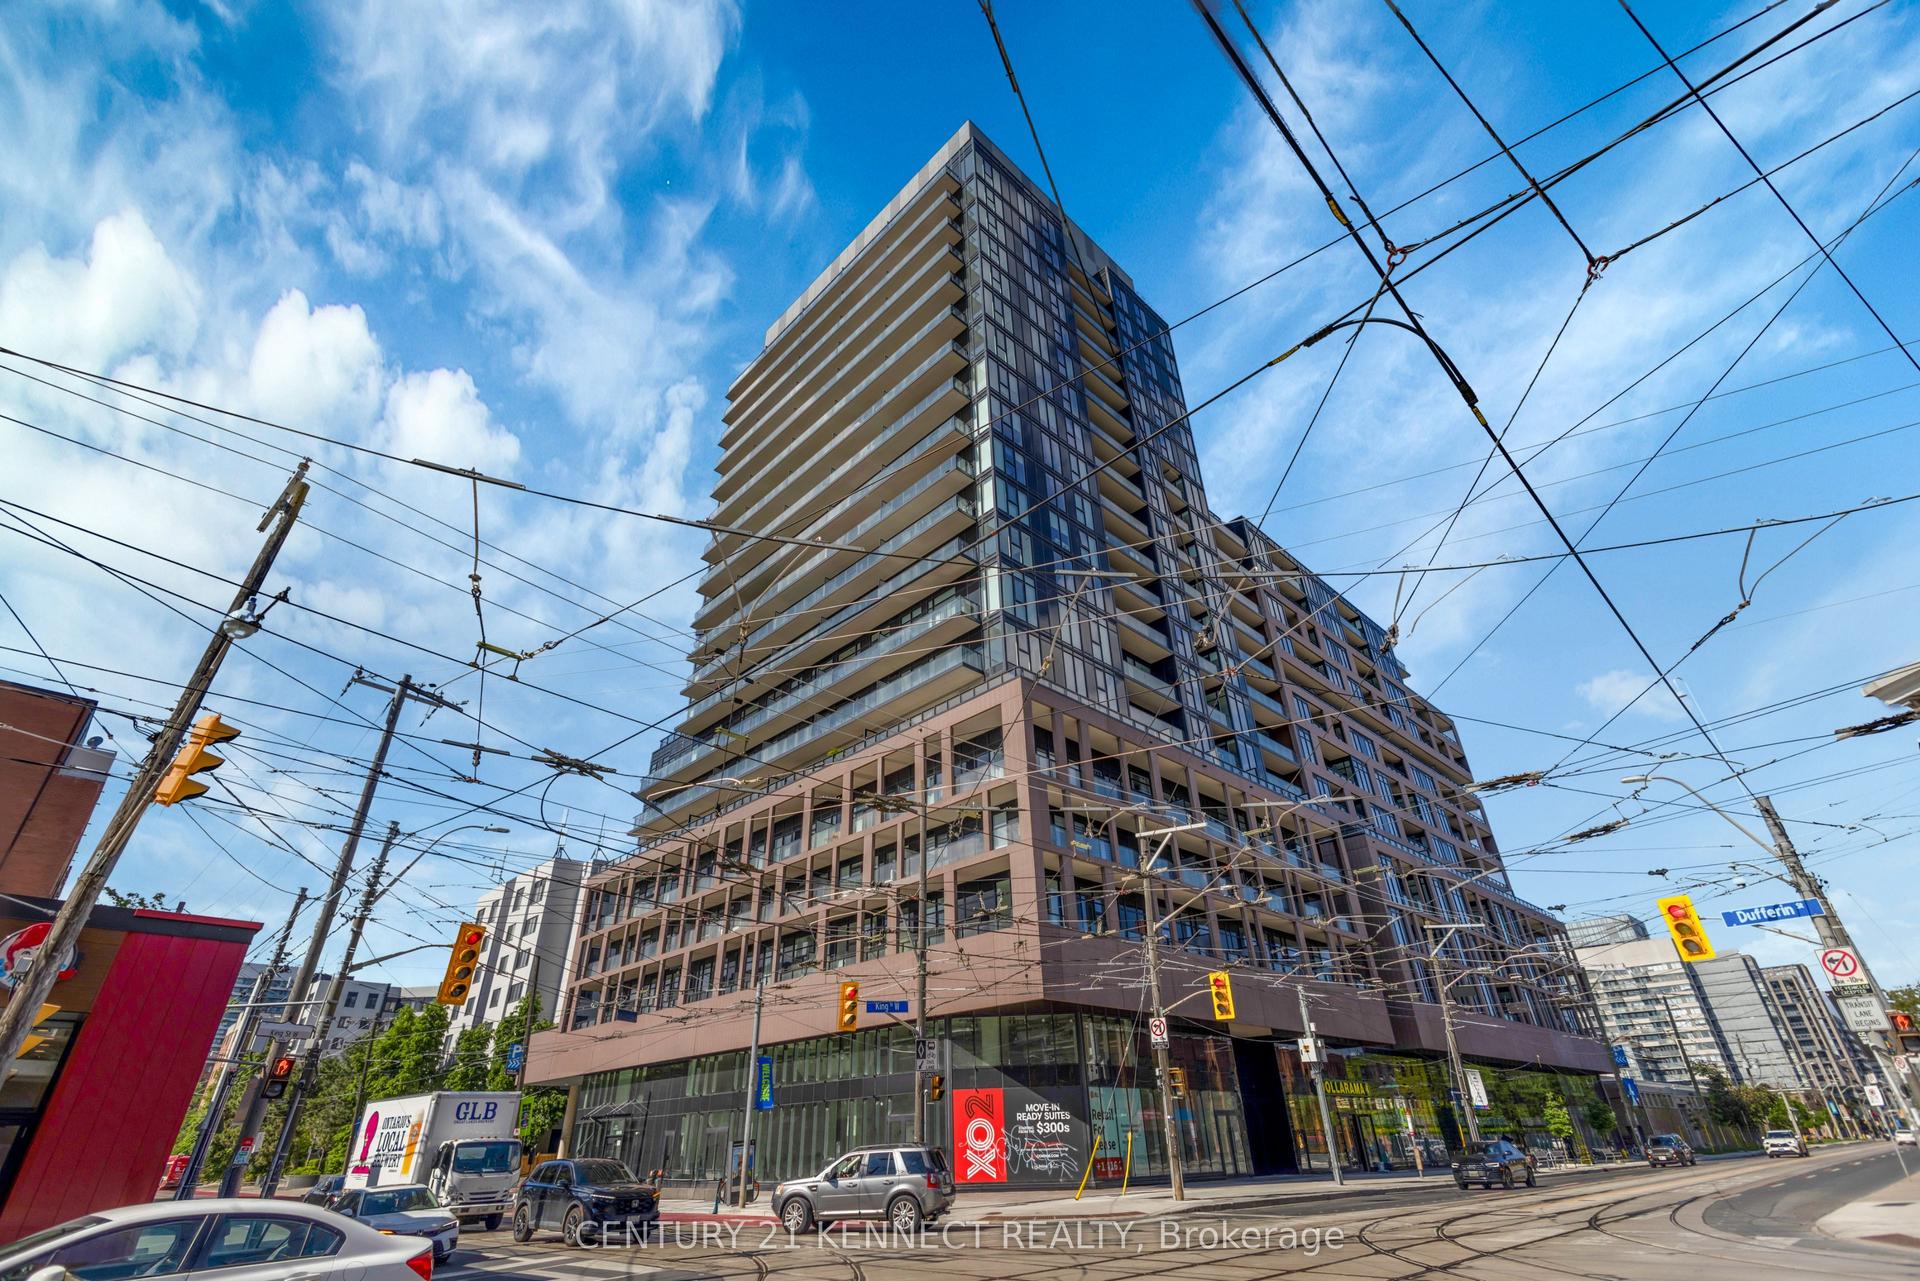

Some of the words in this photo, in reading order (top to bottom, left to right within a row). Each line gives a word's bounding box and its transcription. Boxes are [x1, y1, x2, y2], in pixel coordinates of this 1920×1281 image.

[1736, 905, 1795, 923] Dufferin
[875, 1003, 889, 1011] King
[1845, 1001, 1874, 1009] TRANSIT
[1854, 1010, 1873, 1018] LANE
[1855, 1019, 1881, 1027] BEGINS
[1323, 1080, 1366, 1094] OLLARAMA
[456, 1102, 498, 1120] GLB
[1025, 1103, 1060, 1112] MOVE-IN
[1017, 1112, 1042, 1121] READY
[1044, 1111, 1071, 1120] SUITES
[382, 1114, 413, 1130] ONTARIO'S
[1036, 1121, 1070, 1134] $300s
[376, 1130, 406, 1151] LOCAL
